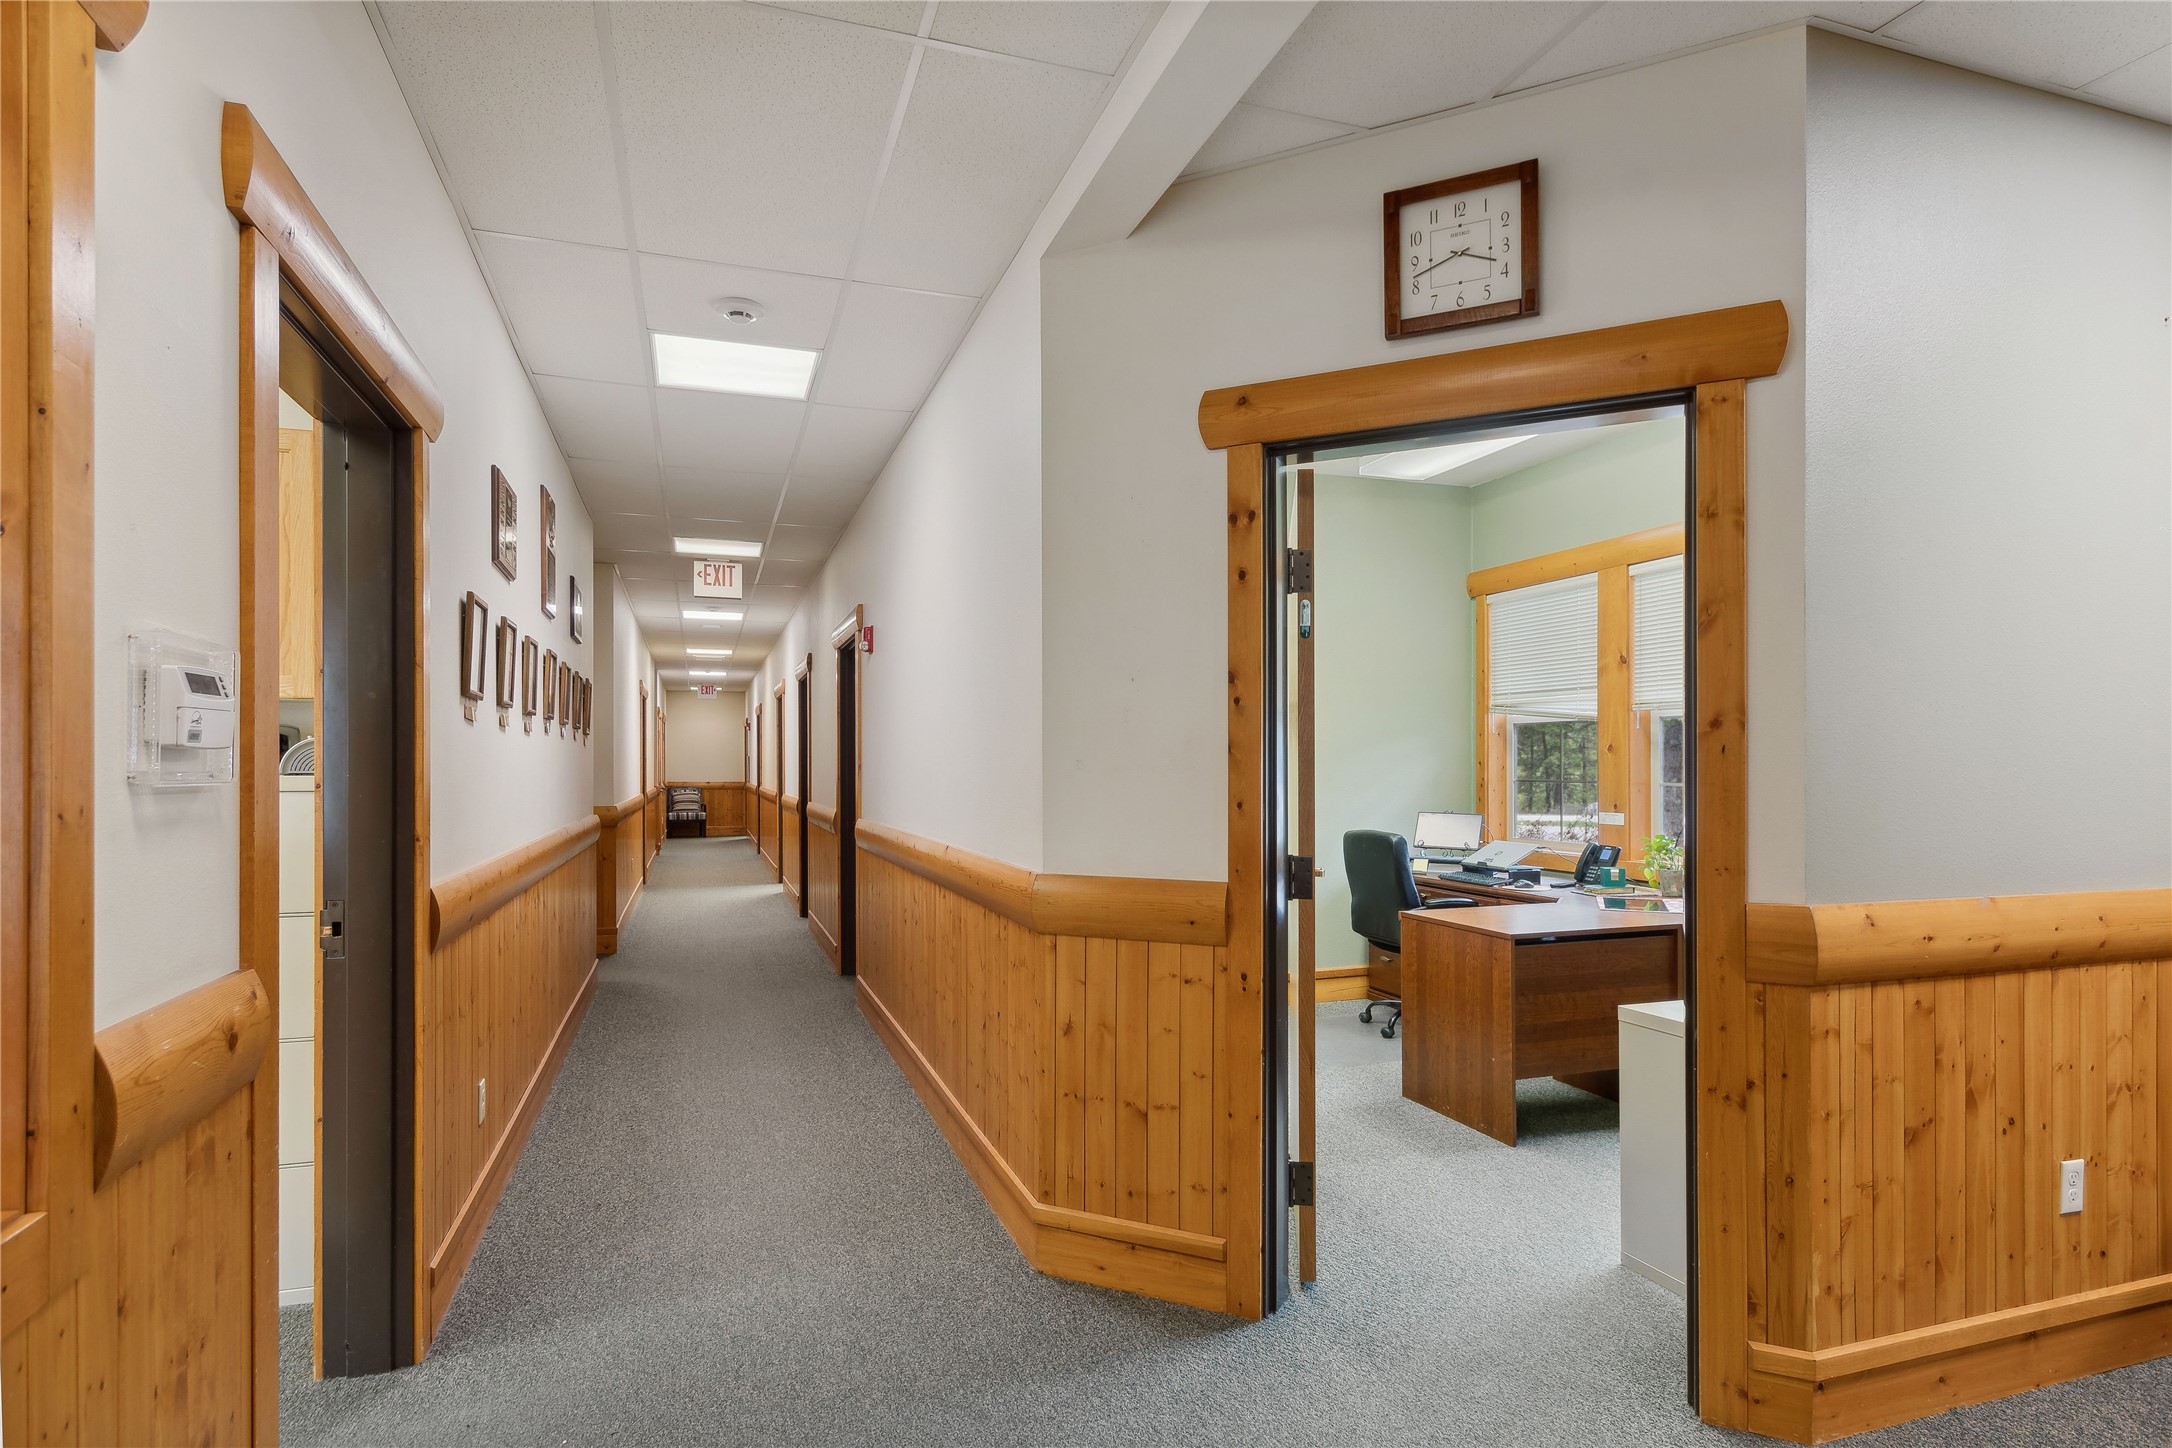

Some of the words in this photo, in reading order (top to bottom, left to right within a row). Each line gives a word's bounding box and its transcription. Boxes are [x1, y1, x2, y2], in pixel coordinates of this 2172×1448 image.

[1429, 209, 1439, 225] 11
[1453, 201, 1466, 218] 12
[1500, 211, 1510, 227] 2
[1410, 231, 1423, 247] 10
[1501, 236, 1510, 253] 3
[1410, 255, 1419, 272] 9
[1500, 261, 1510, 278] 4
[1411, 279, 1420, 296] 8
[1483, 284, 1491, 300] 5
[1430, 294, 1438, 310] 7
[1456, 290, 1465, 307] 6
[703, 563, 736, 587] EXIT
[701, 685, 714, 695] EXIT
